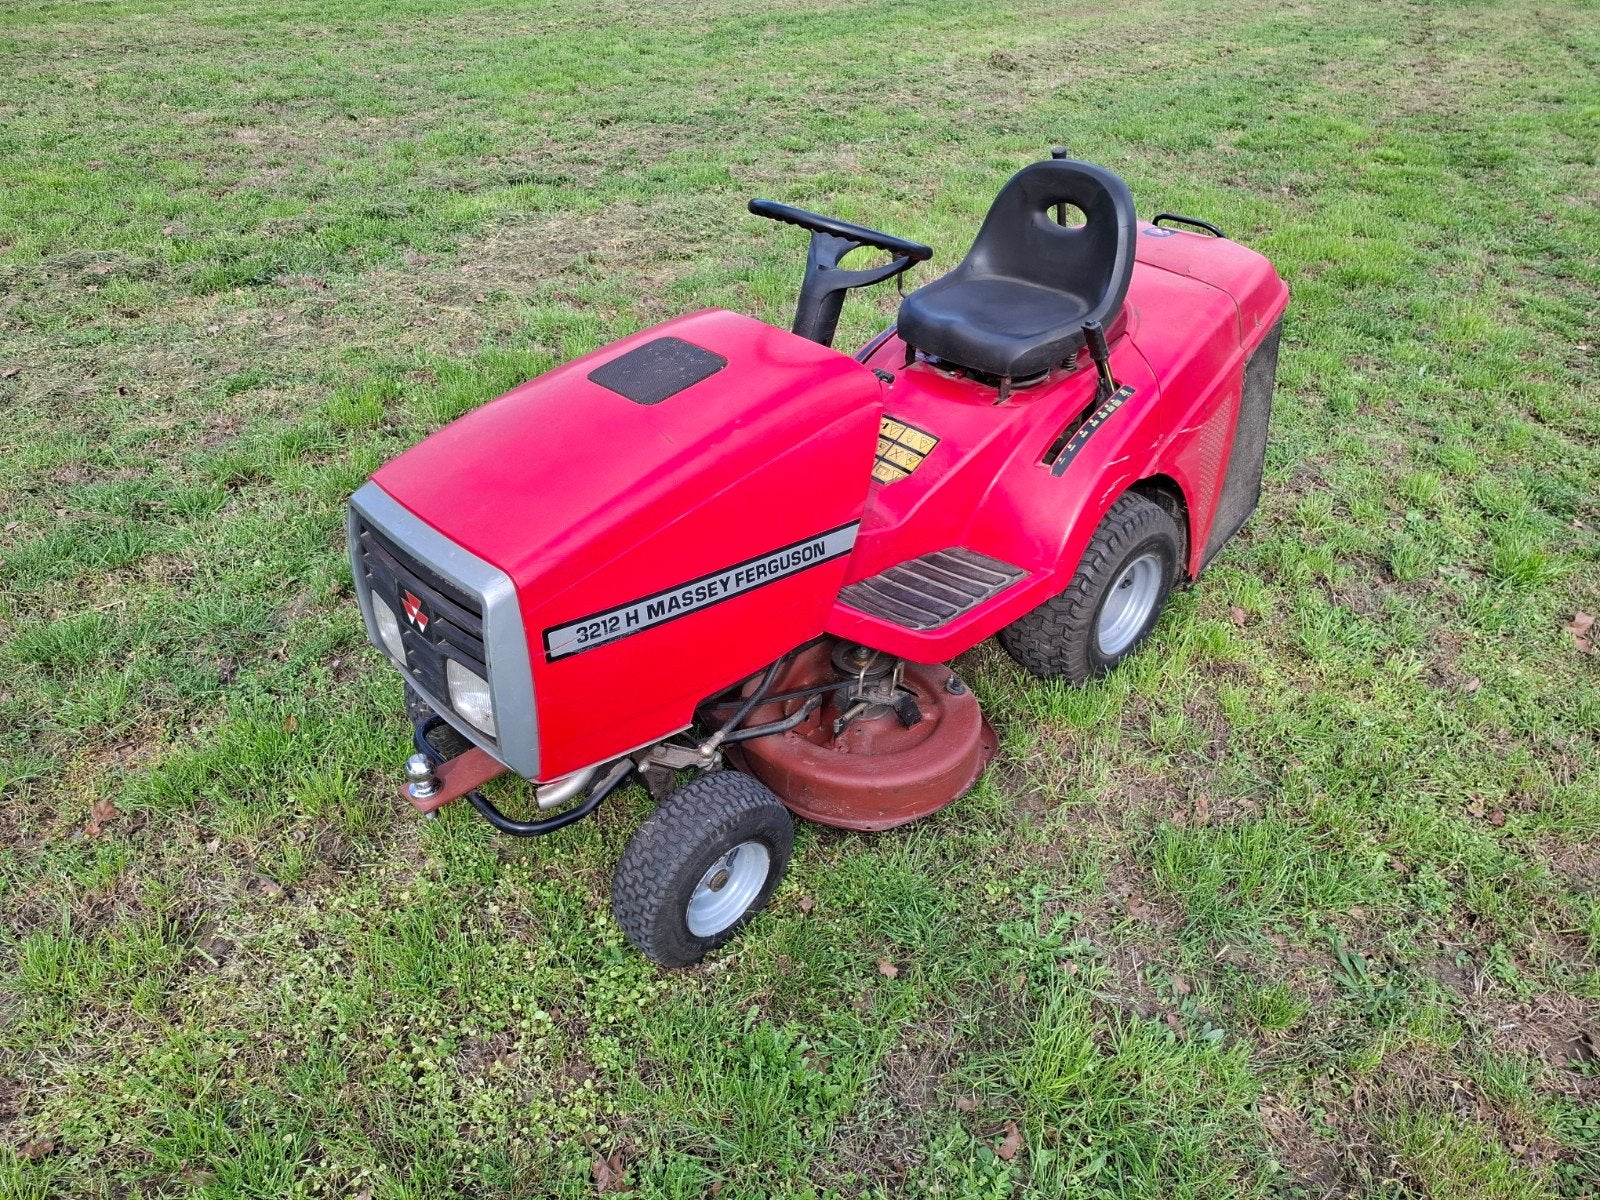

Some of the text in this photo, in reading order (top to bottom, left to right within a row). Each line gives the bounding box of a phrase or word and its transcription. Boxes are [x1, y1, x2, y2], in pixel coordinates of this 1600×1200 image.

[576, 541, 826, 643] 3212 H MASSEY FERGUSON
